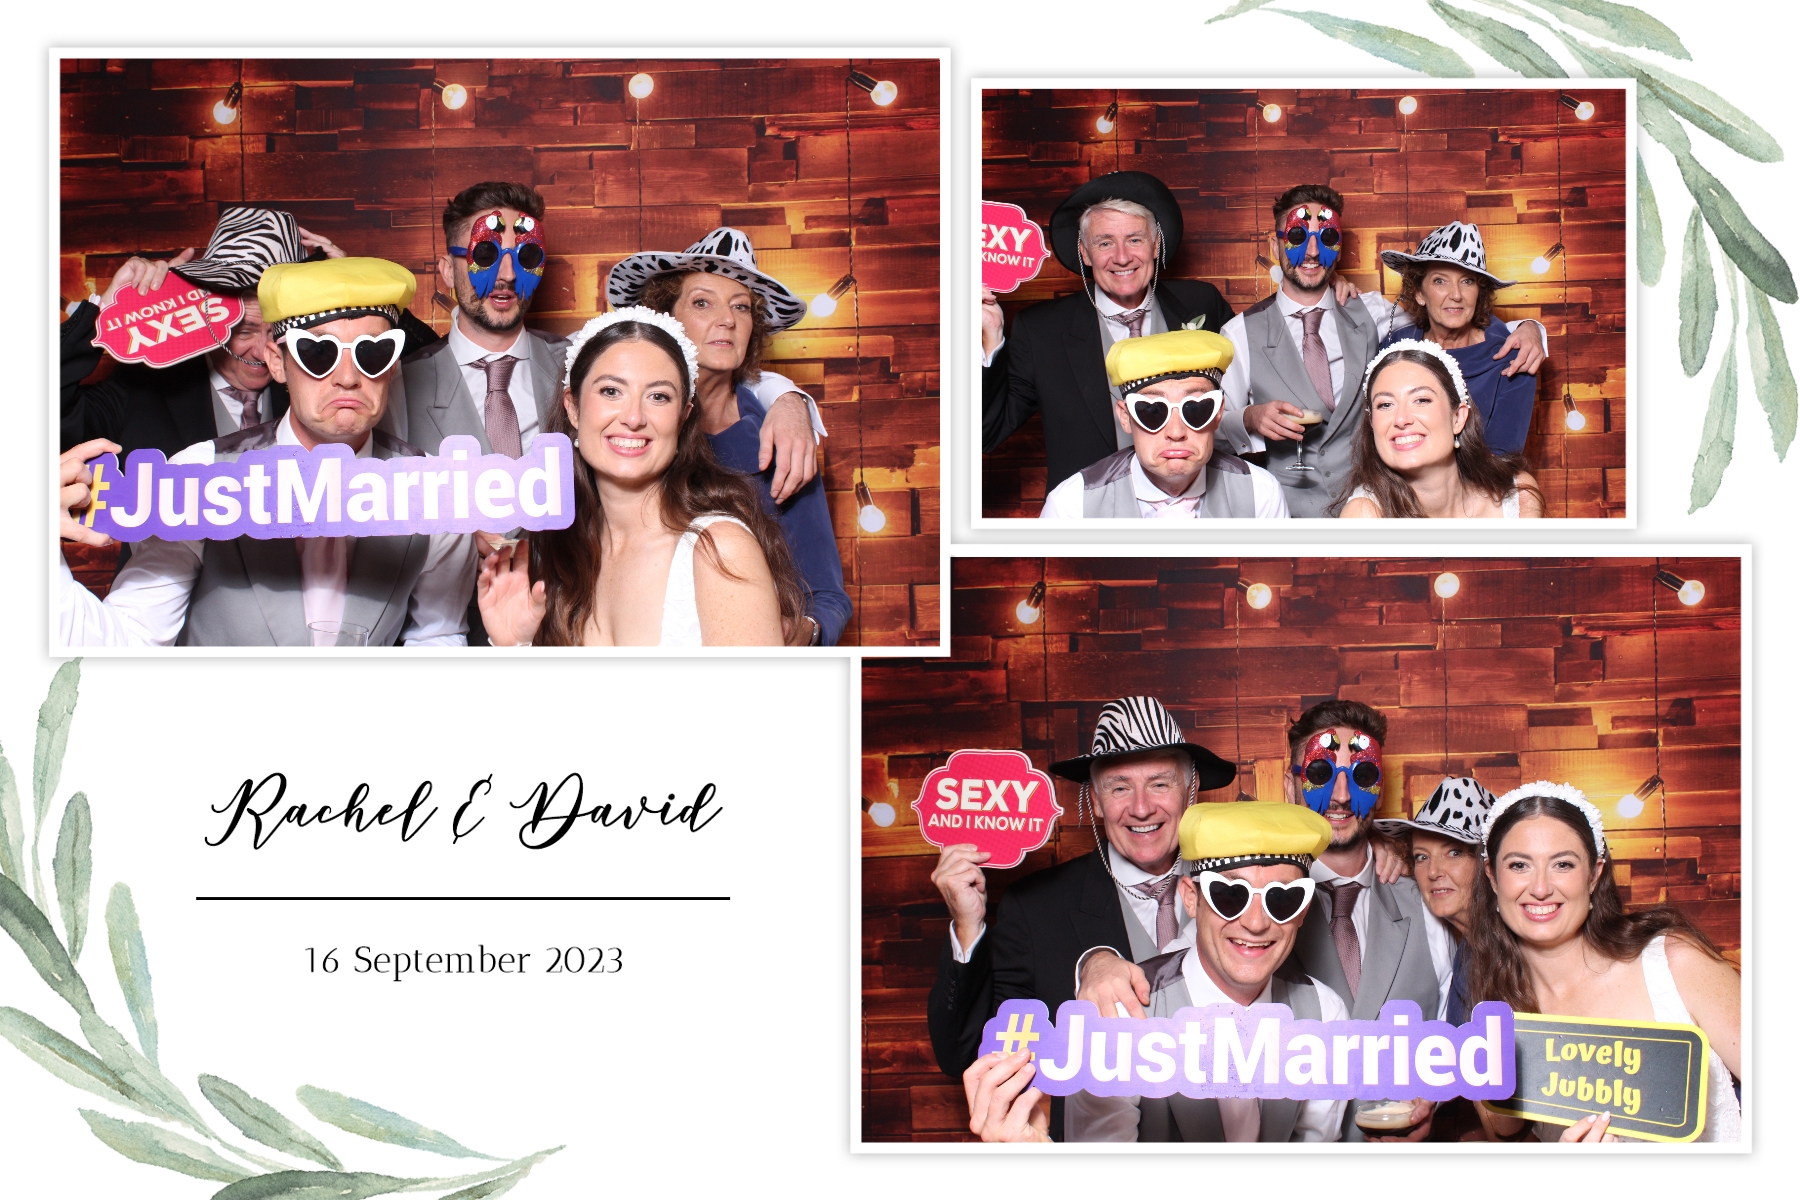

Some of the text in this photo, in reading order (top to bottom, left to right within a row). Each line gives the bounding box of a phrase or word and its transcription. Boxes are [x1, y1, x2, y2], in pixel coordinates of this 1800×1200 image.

[982, 223, 1033, 253] XY
[1022, 257, 1036, 268] IT
[124, 298, 178, 326] KNOW
[177, 295, 186, 305] I
[107, 318, 123, 332] IT
[127, 297, 230, 355] SEXY
[935, 778, 1040, 813] SEXY
[927, 813, 1044, 832] AND I KNOW IT
[992, 1013, 1503, 1087] #JustMarried
[1545, 1038, 1641, 1075] Lovely
[1540, 1072, 1641, 1115] Jubbly
